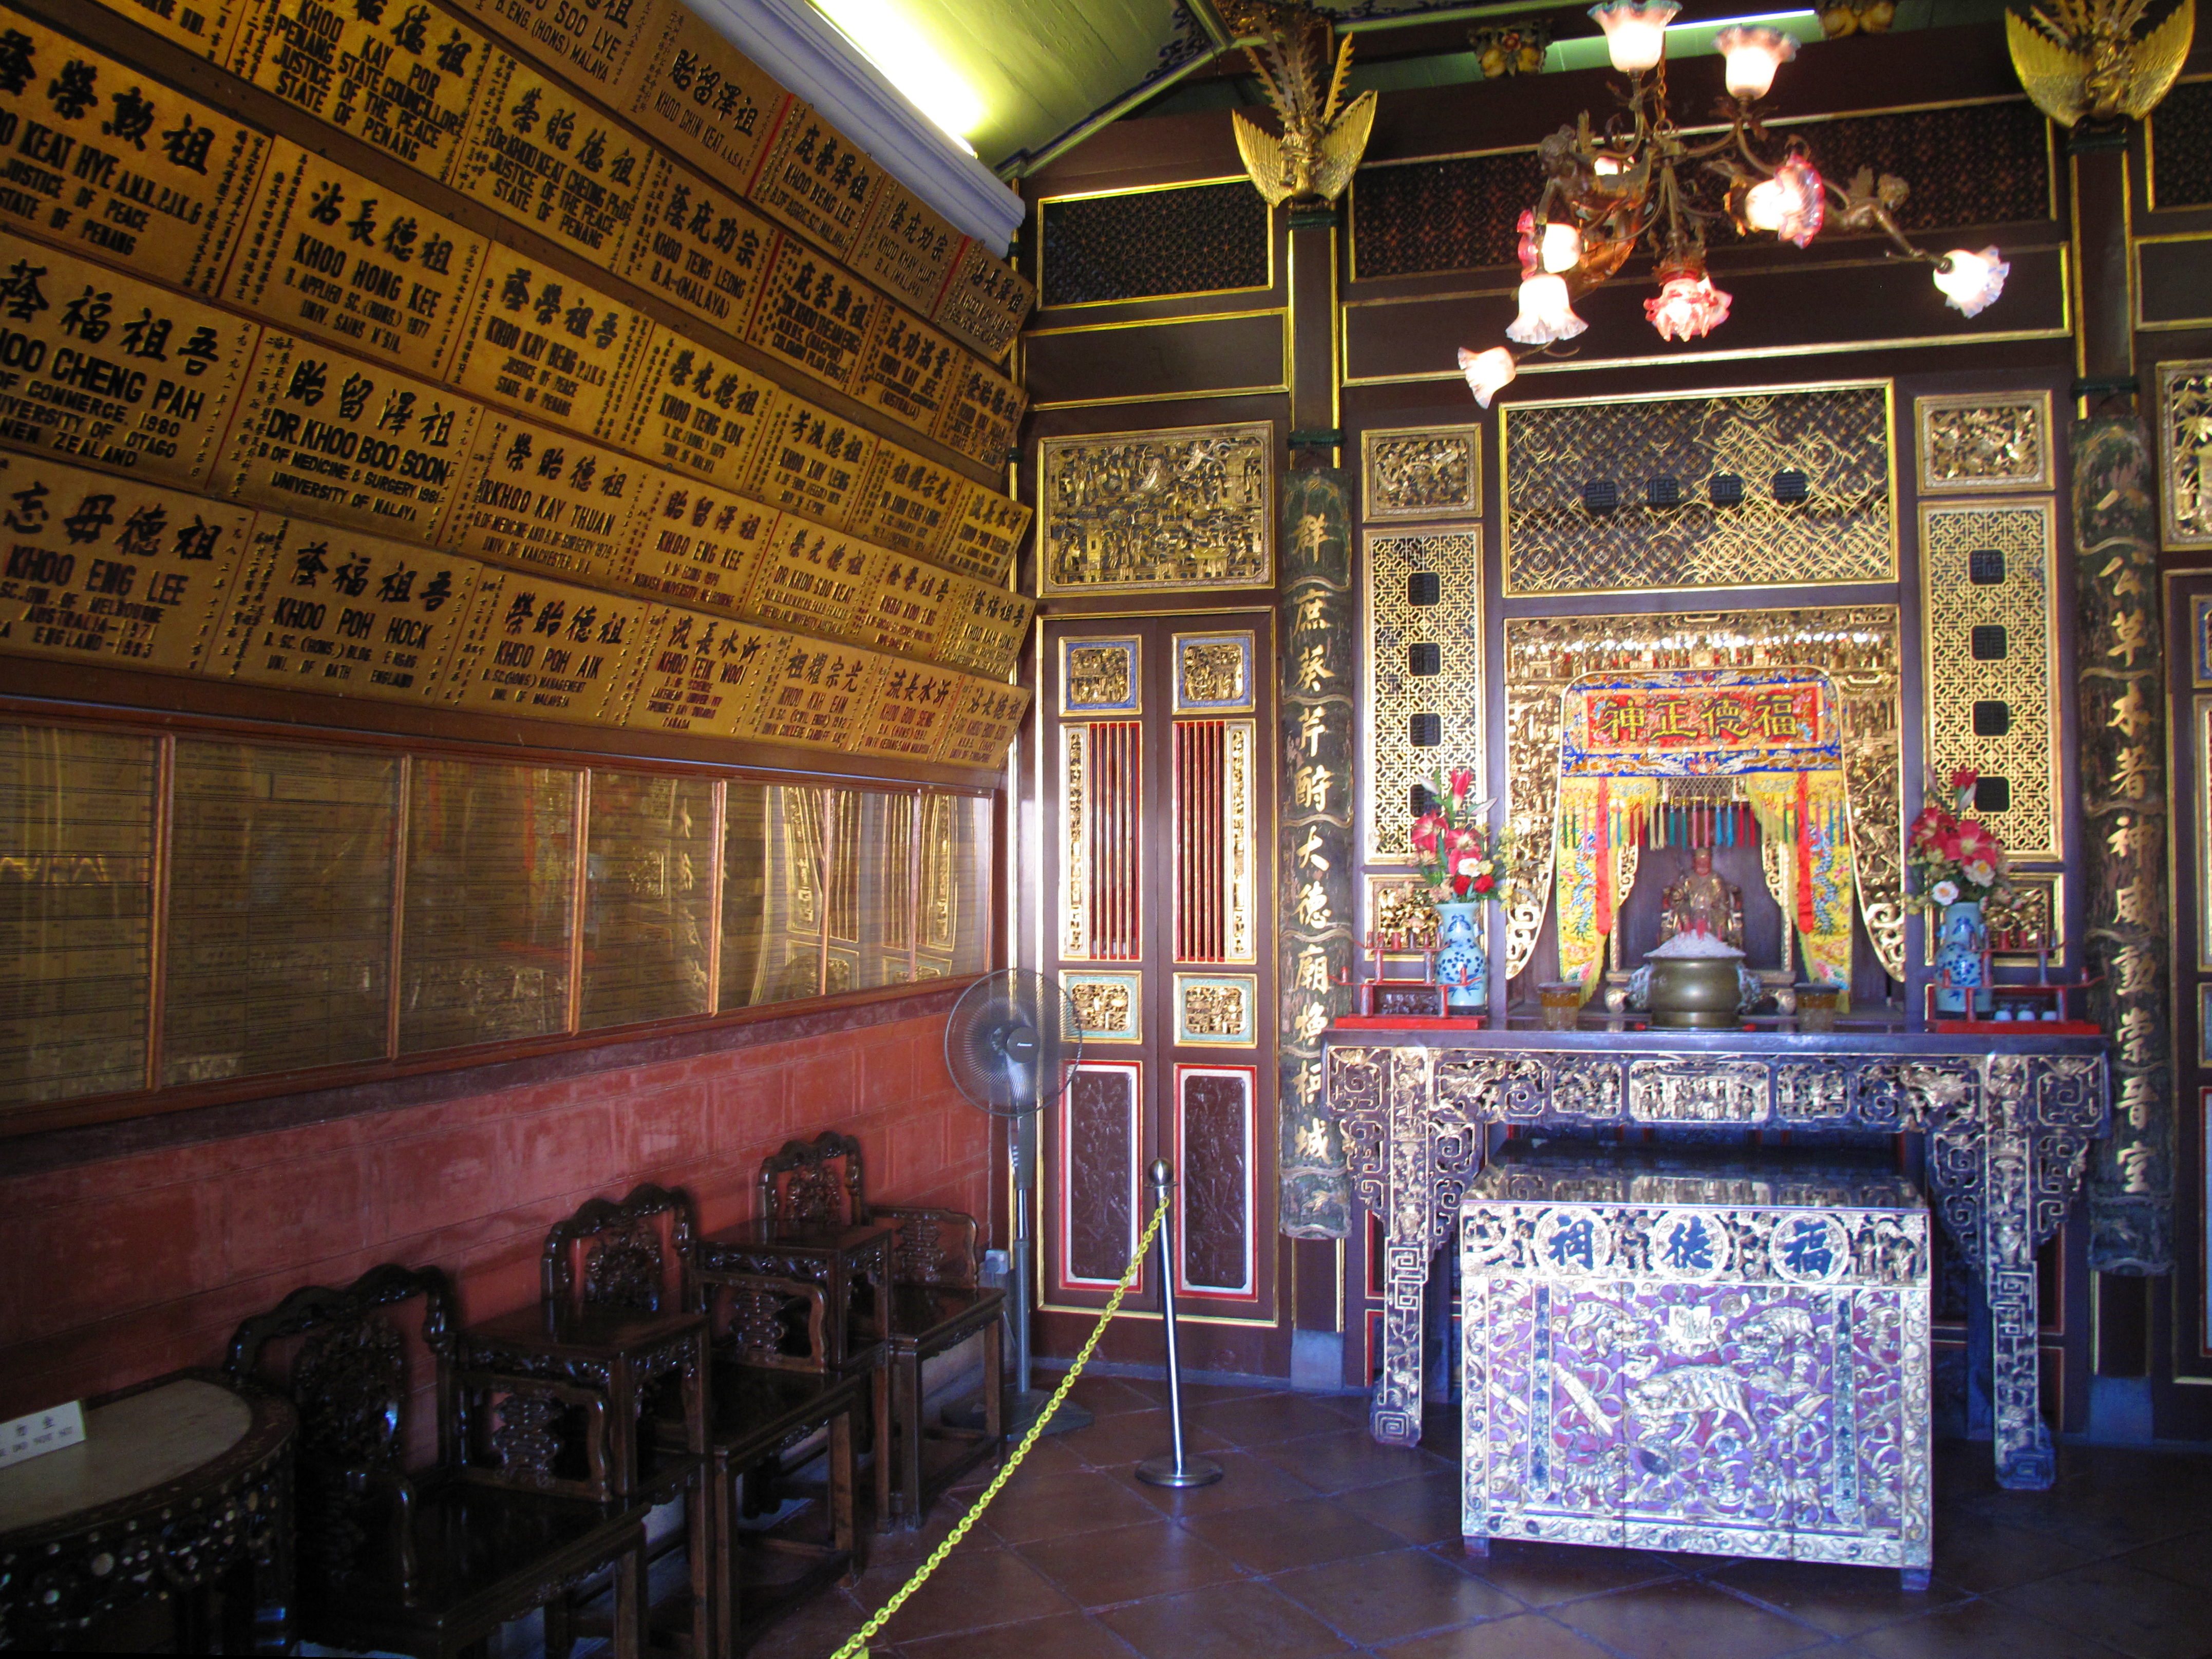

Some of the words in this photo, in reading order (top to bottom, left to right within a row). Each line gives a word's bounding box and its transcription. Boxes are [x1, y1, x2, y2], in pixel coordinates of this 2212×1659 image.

[273, 13, 337, 65] PENANG
[338, 50, 385, 94] STATE
[297, 0, 345, 44] KHOO
[360, 33, 394, 72] KAY
[406, 62, 441, 100] POR
[569, 43, 610, 85] MALAYA
[591, 24, 622, 63] LYE
[272, 40, 337, 93] JUSTICE
[338, 77, 362, 105] OF
[364, 91, 393, 123] THE
[395, 109, 443, 150] PEACE
[275, 70, 329, 114] STATE
[333, 102, 357, 127] OF
[361, 116, 421, 163] PENANG
[654, 89, 682, 123] KHOO
[679, 108, 704, 139] CHIN
[700, 124, 725, 153] KEAT
[18, 119, 76, 171] KEAT
[73, 144, 120, 191] HYE
[535, 150, 569, 186] KEAT
[74, 186, 99, 210] OF
[104, 198, 151, 233] PEACE
[487, 153, 538, 194] JUSTICE
[540, 180, 560, 203] OF
[559, 190, 581, 216] THE
[581, 203, 618, 238] PEACE
[491, 177, 530, 213] STATE
[536, 201, 554, 222] OF
[558, 212, 604, 251] PENANG
[782, 160, 812, 196] KHOO
[808, 182, 837, 214] BENG
[833, 200, 856, 229] LEE
[49, 208, 74, 231] OF
[81, 219, 137, 256] PENANG
[876, 234, 900, 260] KHOO
[896, 249, 919, 274] KHAY
[294, 232, 348, 278] KHOO
[351, 259, 405, 302] HONG
[407, 282, 443, 319] KEE
[652, 230, 683, 264] KHOO
[685, 249, 714, 281] TENG
[299, 273, 344, 306] APPLIED
[958, 290, 981, 314] KHOO
[332, 312, 367, 340] SAINS
[484, 314, 522, 351] KHOO
[519, 330, 549, 362] KAY
[544, 341, 579, 375] BENG
[51, 347, 148, 404] CHENG
[152, 378, 206, 424] PAH
[139, 410, 181, 439] 1980
[658, 391, 693, 425] KHOO
[691, 406, 722, 437] TENG
[53, 430, 139, 468] ZEALAND
[90, 420, 116, 439] OF
[125, 430, 178, 460] OTAGO
[298, 419, 358, 461] KHOO
[356, 435, 401, 472] BOO
[399, 448, 452, 486] SOON
[271, 445, 292, 464] OF
[290, 449, 352, 481] MEDICINE
[363, 470, 419, 499] SURGERY
[415, 485, 442, 505] 1981
[778, 446, 807, 474] KHOO
[806, 458, 829, 482] KAY
[271, 471, 351, 505] UNIVERSITY
[350, 492, 371, 511] OF
[371, 498, 418, 522] MALAYA
[488, 480, 533, 514] KHOO
[534, 493, 568, 523] KAY
[569, 503, 617, 538] THUAN
[655, 529, 692, 556] KHOO
[691, 539, 720, 564] ENG
[719, 546, 746, 572] KEE
[5, 544, 77, 588] KHOO
[84, 558, 138, 597] ENG
[145, 570, 191, 607] LEE
[788, 569, 815, 593] KHOO
[812, 577, 834, 599] SOO
[830, 581, 857, 605] KEAT
[61, 591, 80, 611] OF
[88, 596, 166, 625] MELBOURNE
[272, 596, 327, 631] KHOO
[335, 606, 376, 640] POH
[383, 616, 434, 651] HOCK
[877, 593, 903, 616] KHOO
[961, 621, 984, 642] KHOO
[980, 627, 999, 647] KAH
[995, 631, 1016, 651] HONG
[298, 659, 315, 674] OF
[322, 662, 353, 681] BATH
[369, 668, 415, 689] ENGLAND
[492, 638, 536, 669] KHOO
[540, 646, 572, 674] POH
[574, 654, 604, 681] AIK
[657, 650, 689, 675] KHOO
[690, 656, 717, 681] TEIK
[719, 662, 749, 686] WOOI
[777, 685, 804, 708] KHOO
[806, 691, 827, 712] KAH
[878, 702, 902, 723] KHOO
[900, 706, 917, 725] BOO
[916, 709, 937, 728] SENG
